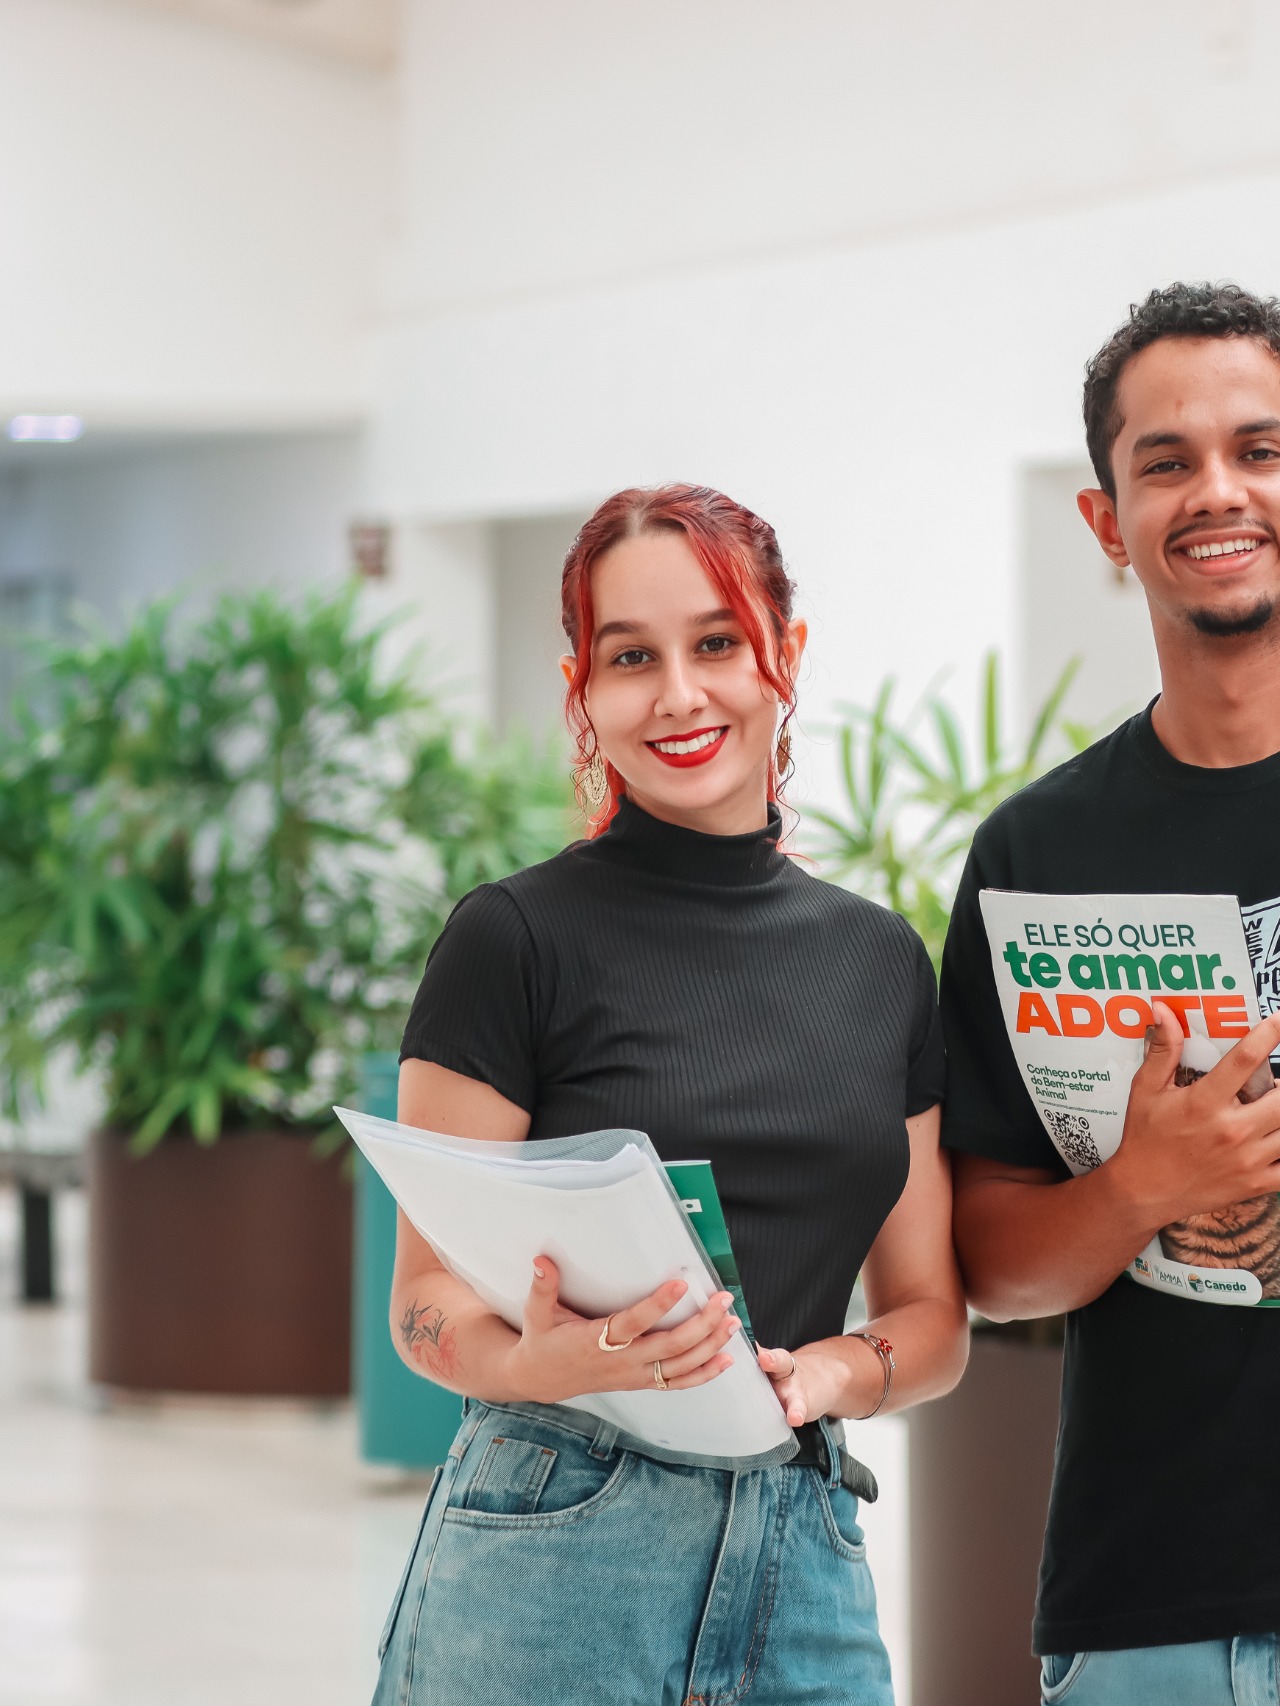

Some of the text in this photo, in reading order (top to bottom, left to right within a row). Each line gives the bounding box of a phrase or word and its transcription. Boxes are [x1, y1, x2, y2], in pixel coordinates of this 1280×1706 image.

[1023, 917, 1196, 952] ELE SÓ QUER
[1002, 941, 1237, 991] te amar.
[1016, 991, 1251, 1039] ADOTE
[1026, 1063, 1111, 1082] Conheça o Portal
[1031, 1075, 1094, 1092] do Bem-estar
[1035, 1086, 1068, 1101] Animal
[1204, 1279, 1247, 1291] Canedo
